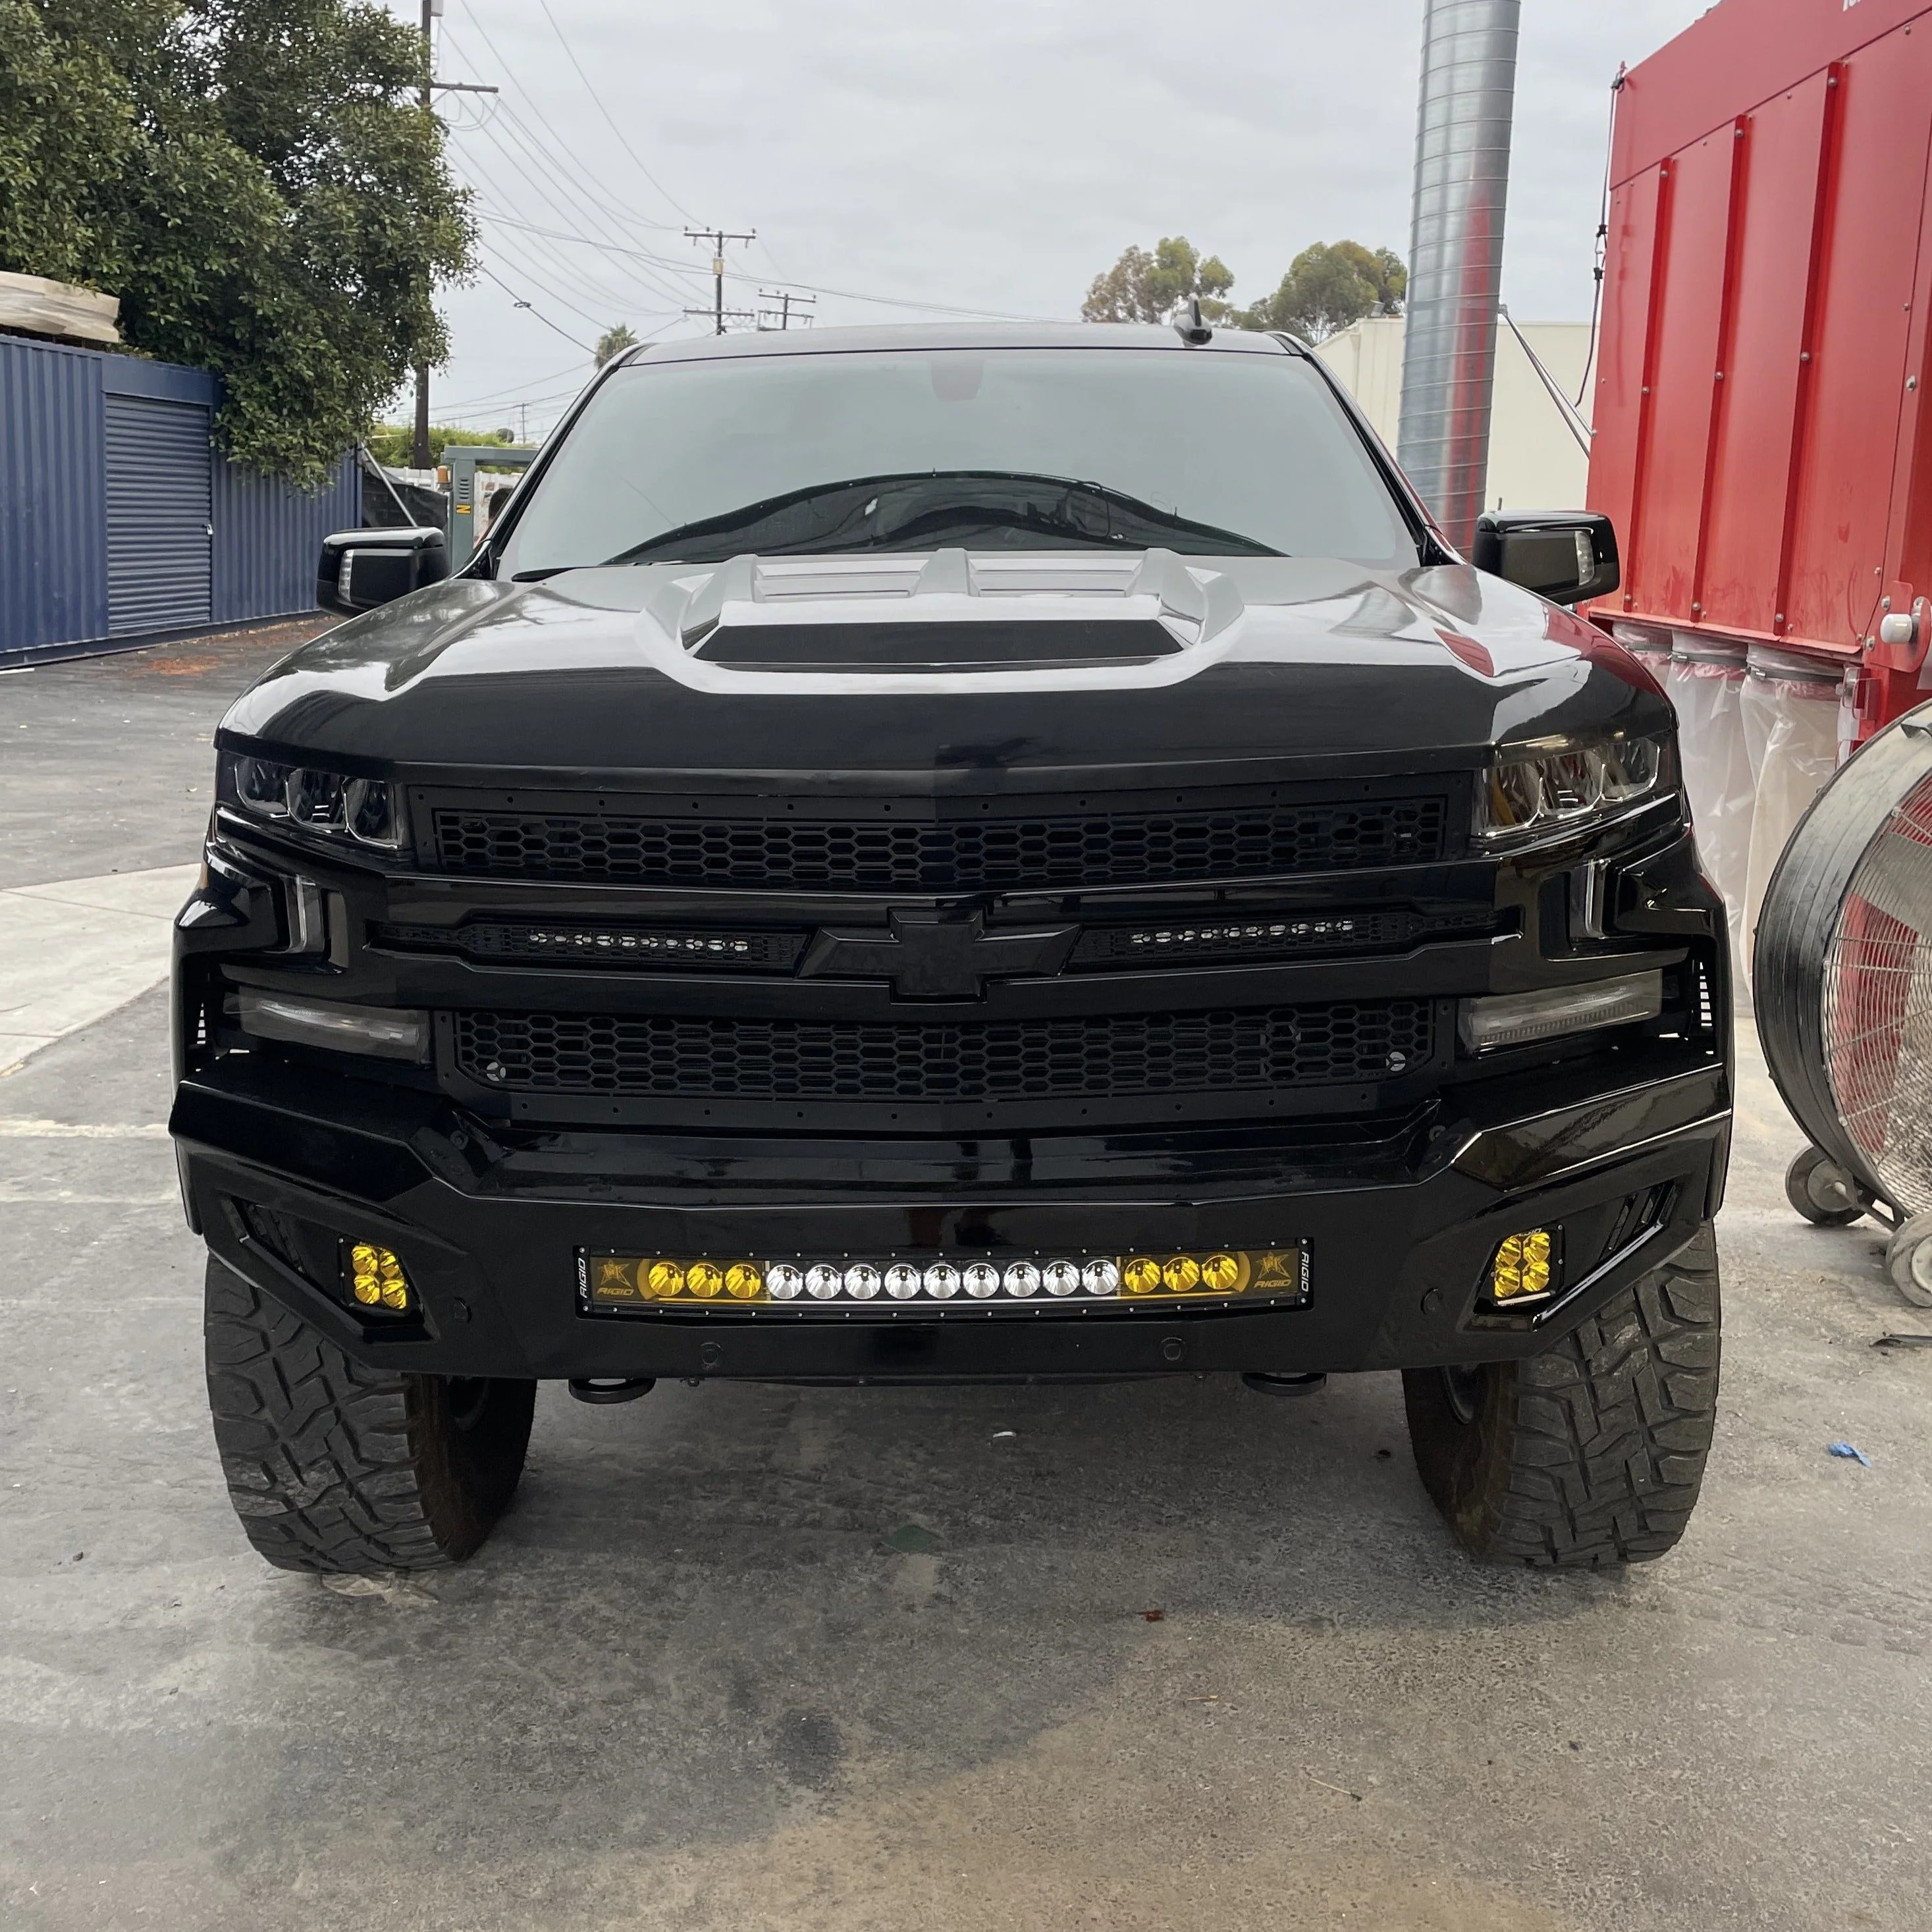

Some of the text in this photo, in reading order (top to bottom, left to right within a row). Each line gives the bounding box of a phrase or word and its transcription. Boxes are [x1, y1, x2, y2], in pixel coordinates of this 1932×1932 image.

[578, 1258, 587, 1299] RIGID
[1254, 1279, 1291, 1288] RIGID
[597, 1287, 634, 1296] RIGID
